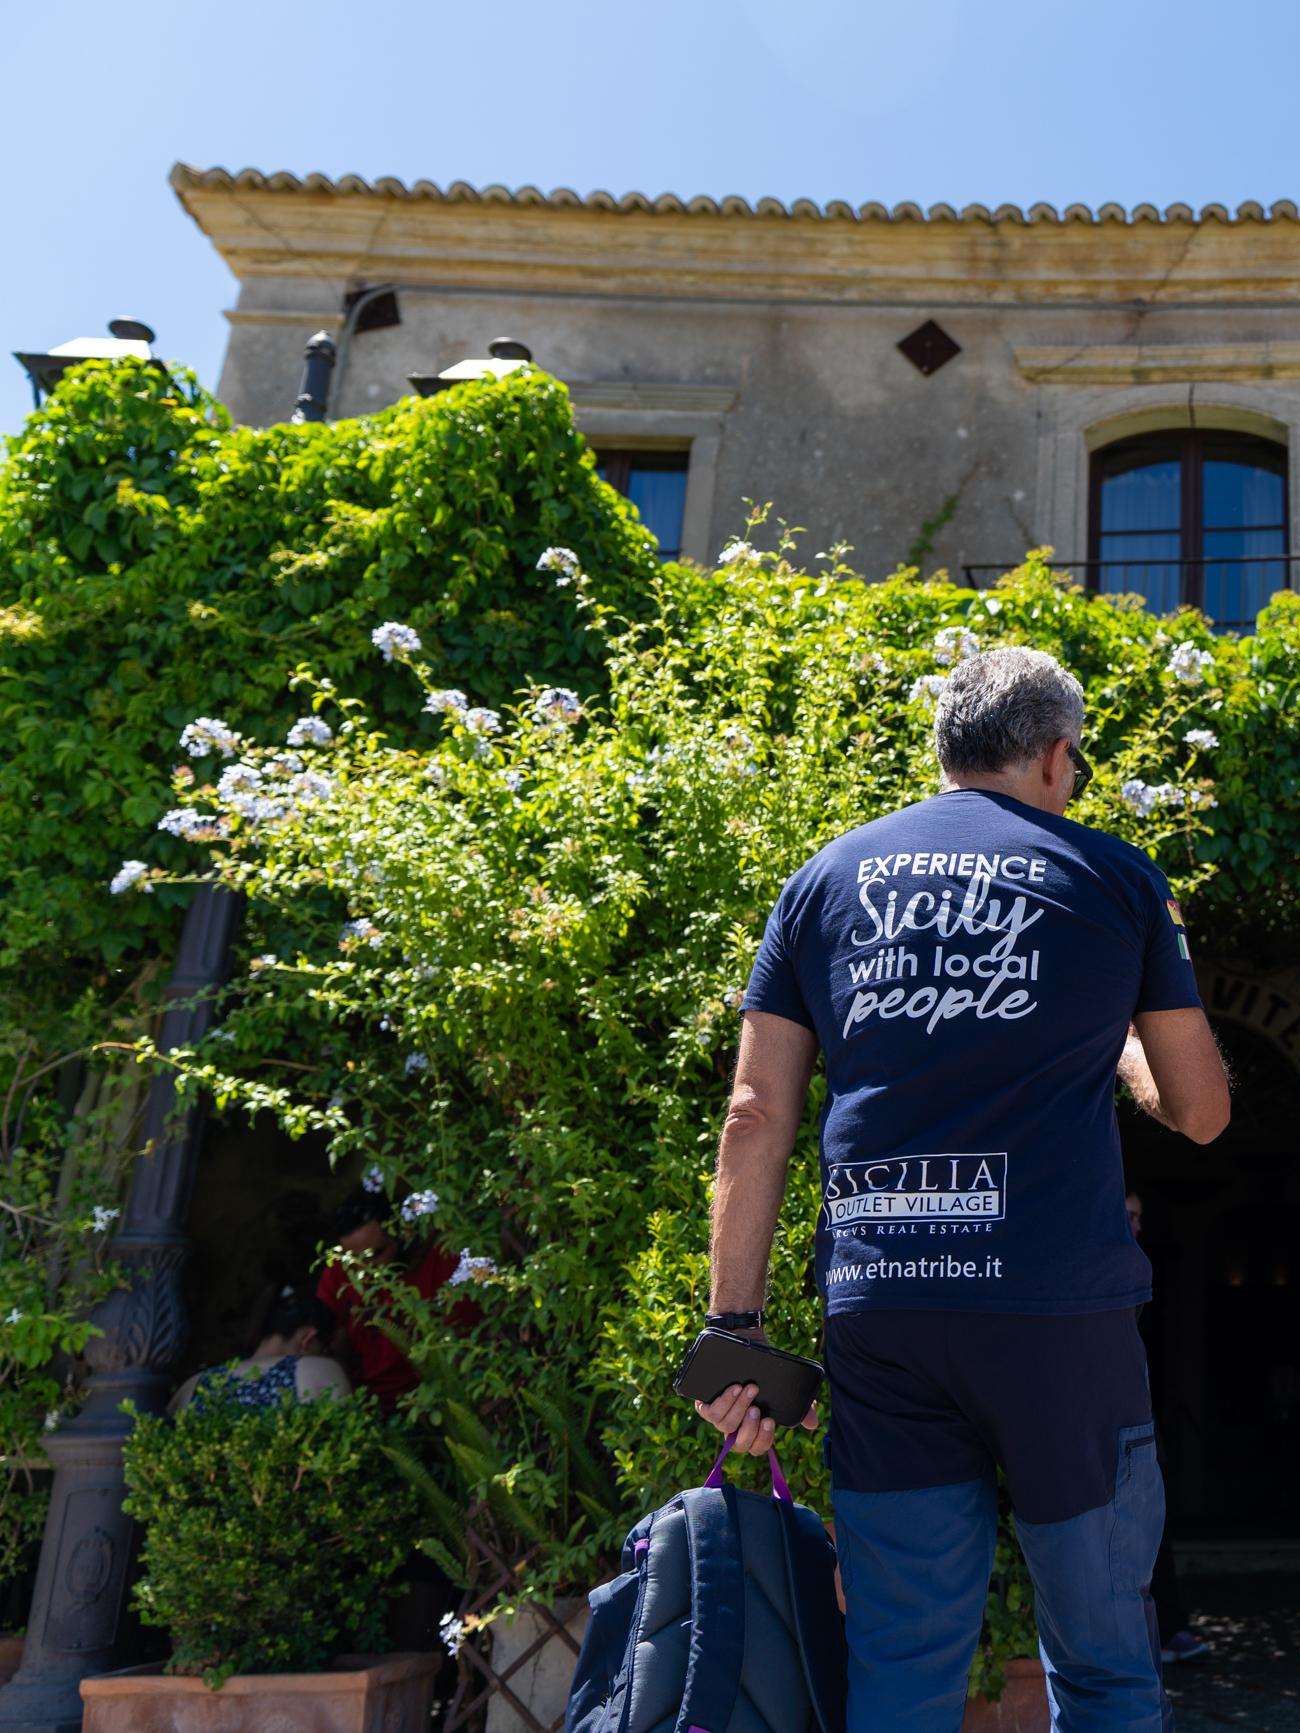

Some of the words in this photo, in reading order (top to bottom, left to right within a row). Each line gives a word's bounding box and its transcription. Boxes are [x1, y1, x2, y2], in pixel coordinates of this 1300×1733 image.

[857, 853, 1047, 883] EXPERIENCE
[851, 872, 1045, 962] Sicily
[848, 946, 918, 984] with
[933, 946, 1040, 981] local
[843, 970, 1037, 1040] people
[826, 1159, 998, 1199] SICILIA
[835, 1196, 896, 1219] OUTLET
[905, 1195, 993, 1213] VILLAGE
[876, 1224, 918, 1235] REAL
[929, 1222, 993, 1235] ESTATE
[826, 1254, 1002, 1286] www.etnatribe.it
